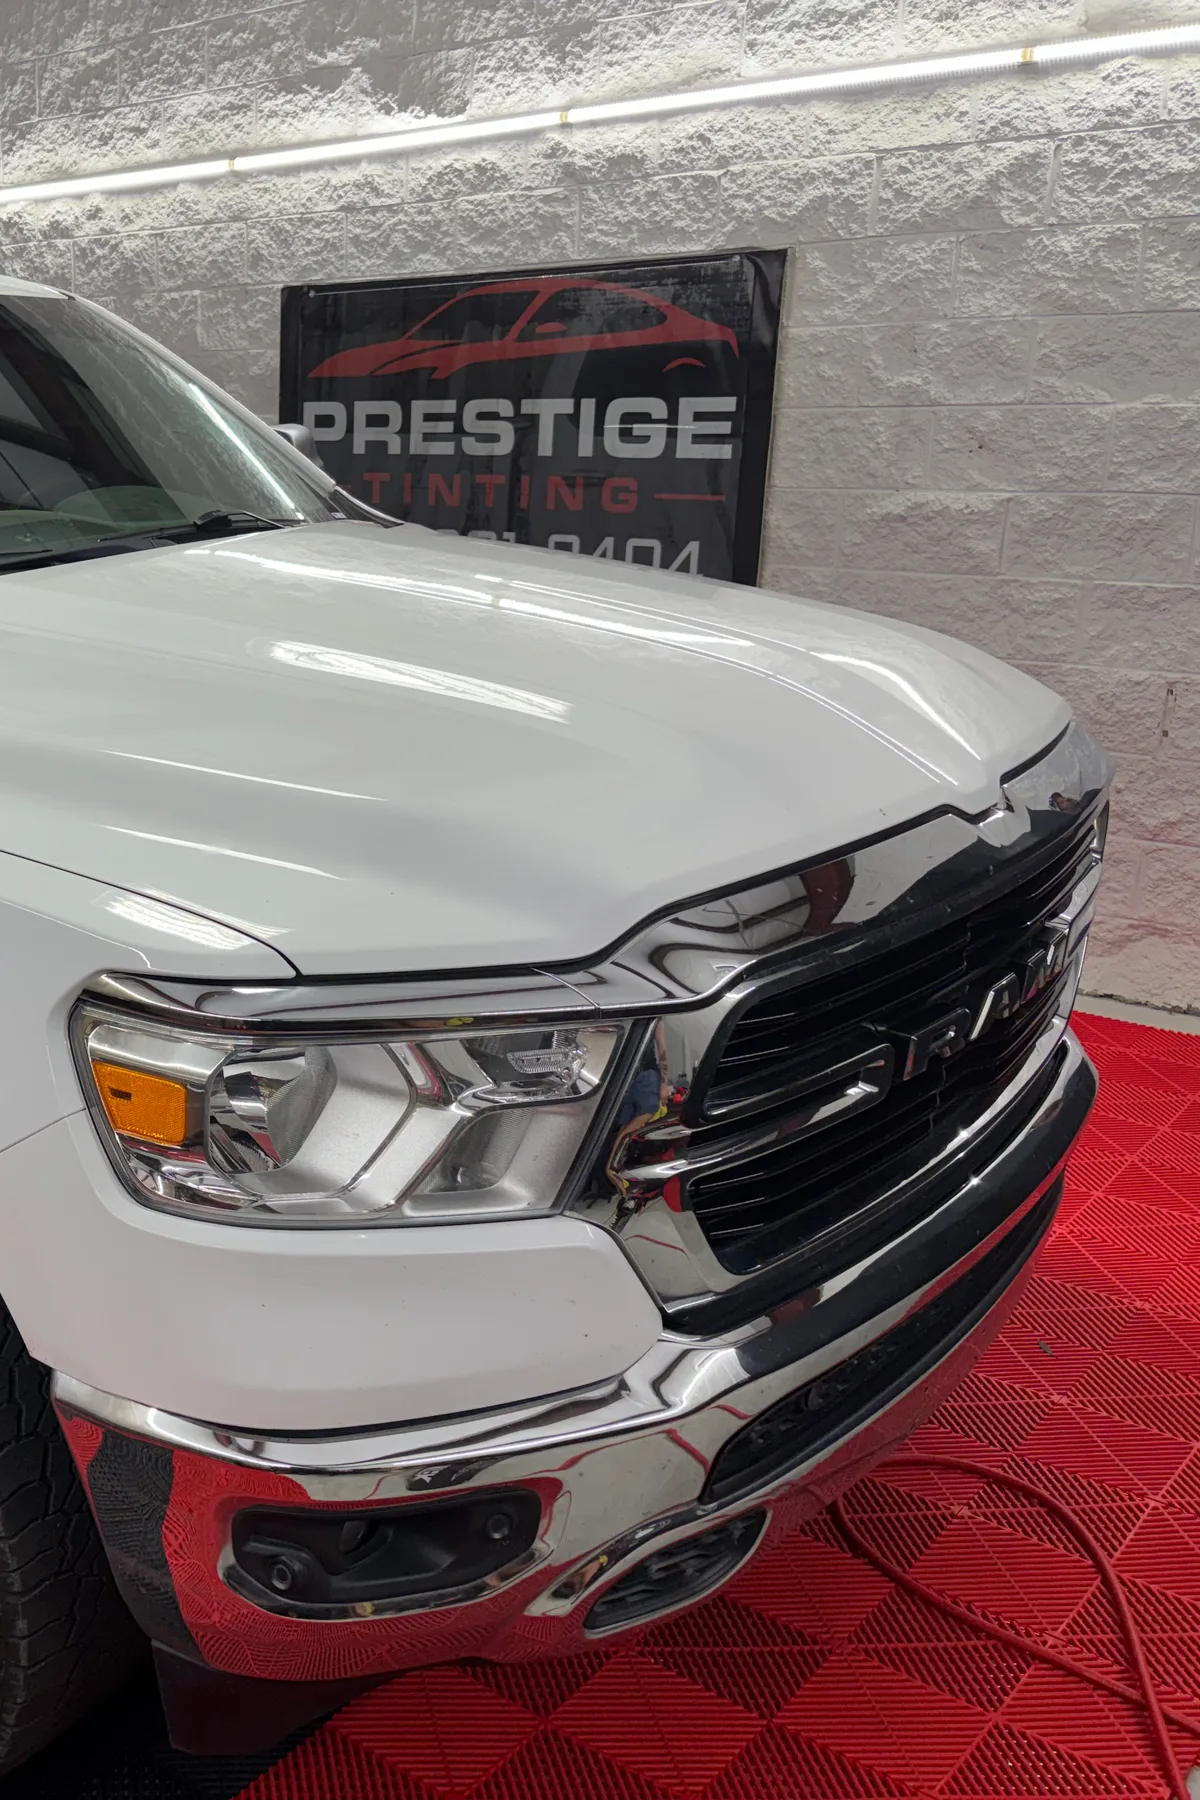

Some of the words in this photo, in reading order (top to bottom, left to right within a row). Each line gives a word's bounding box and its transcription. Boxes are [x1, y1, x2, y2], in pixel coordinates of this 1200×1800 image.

[303, 396, 737, 459] PRESTIGE
[363, 472, 638, 514] TINTING
[903, 926, 1070, 1081] RAM
